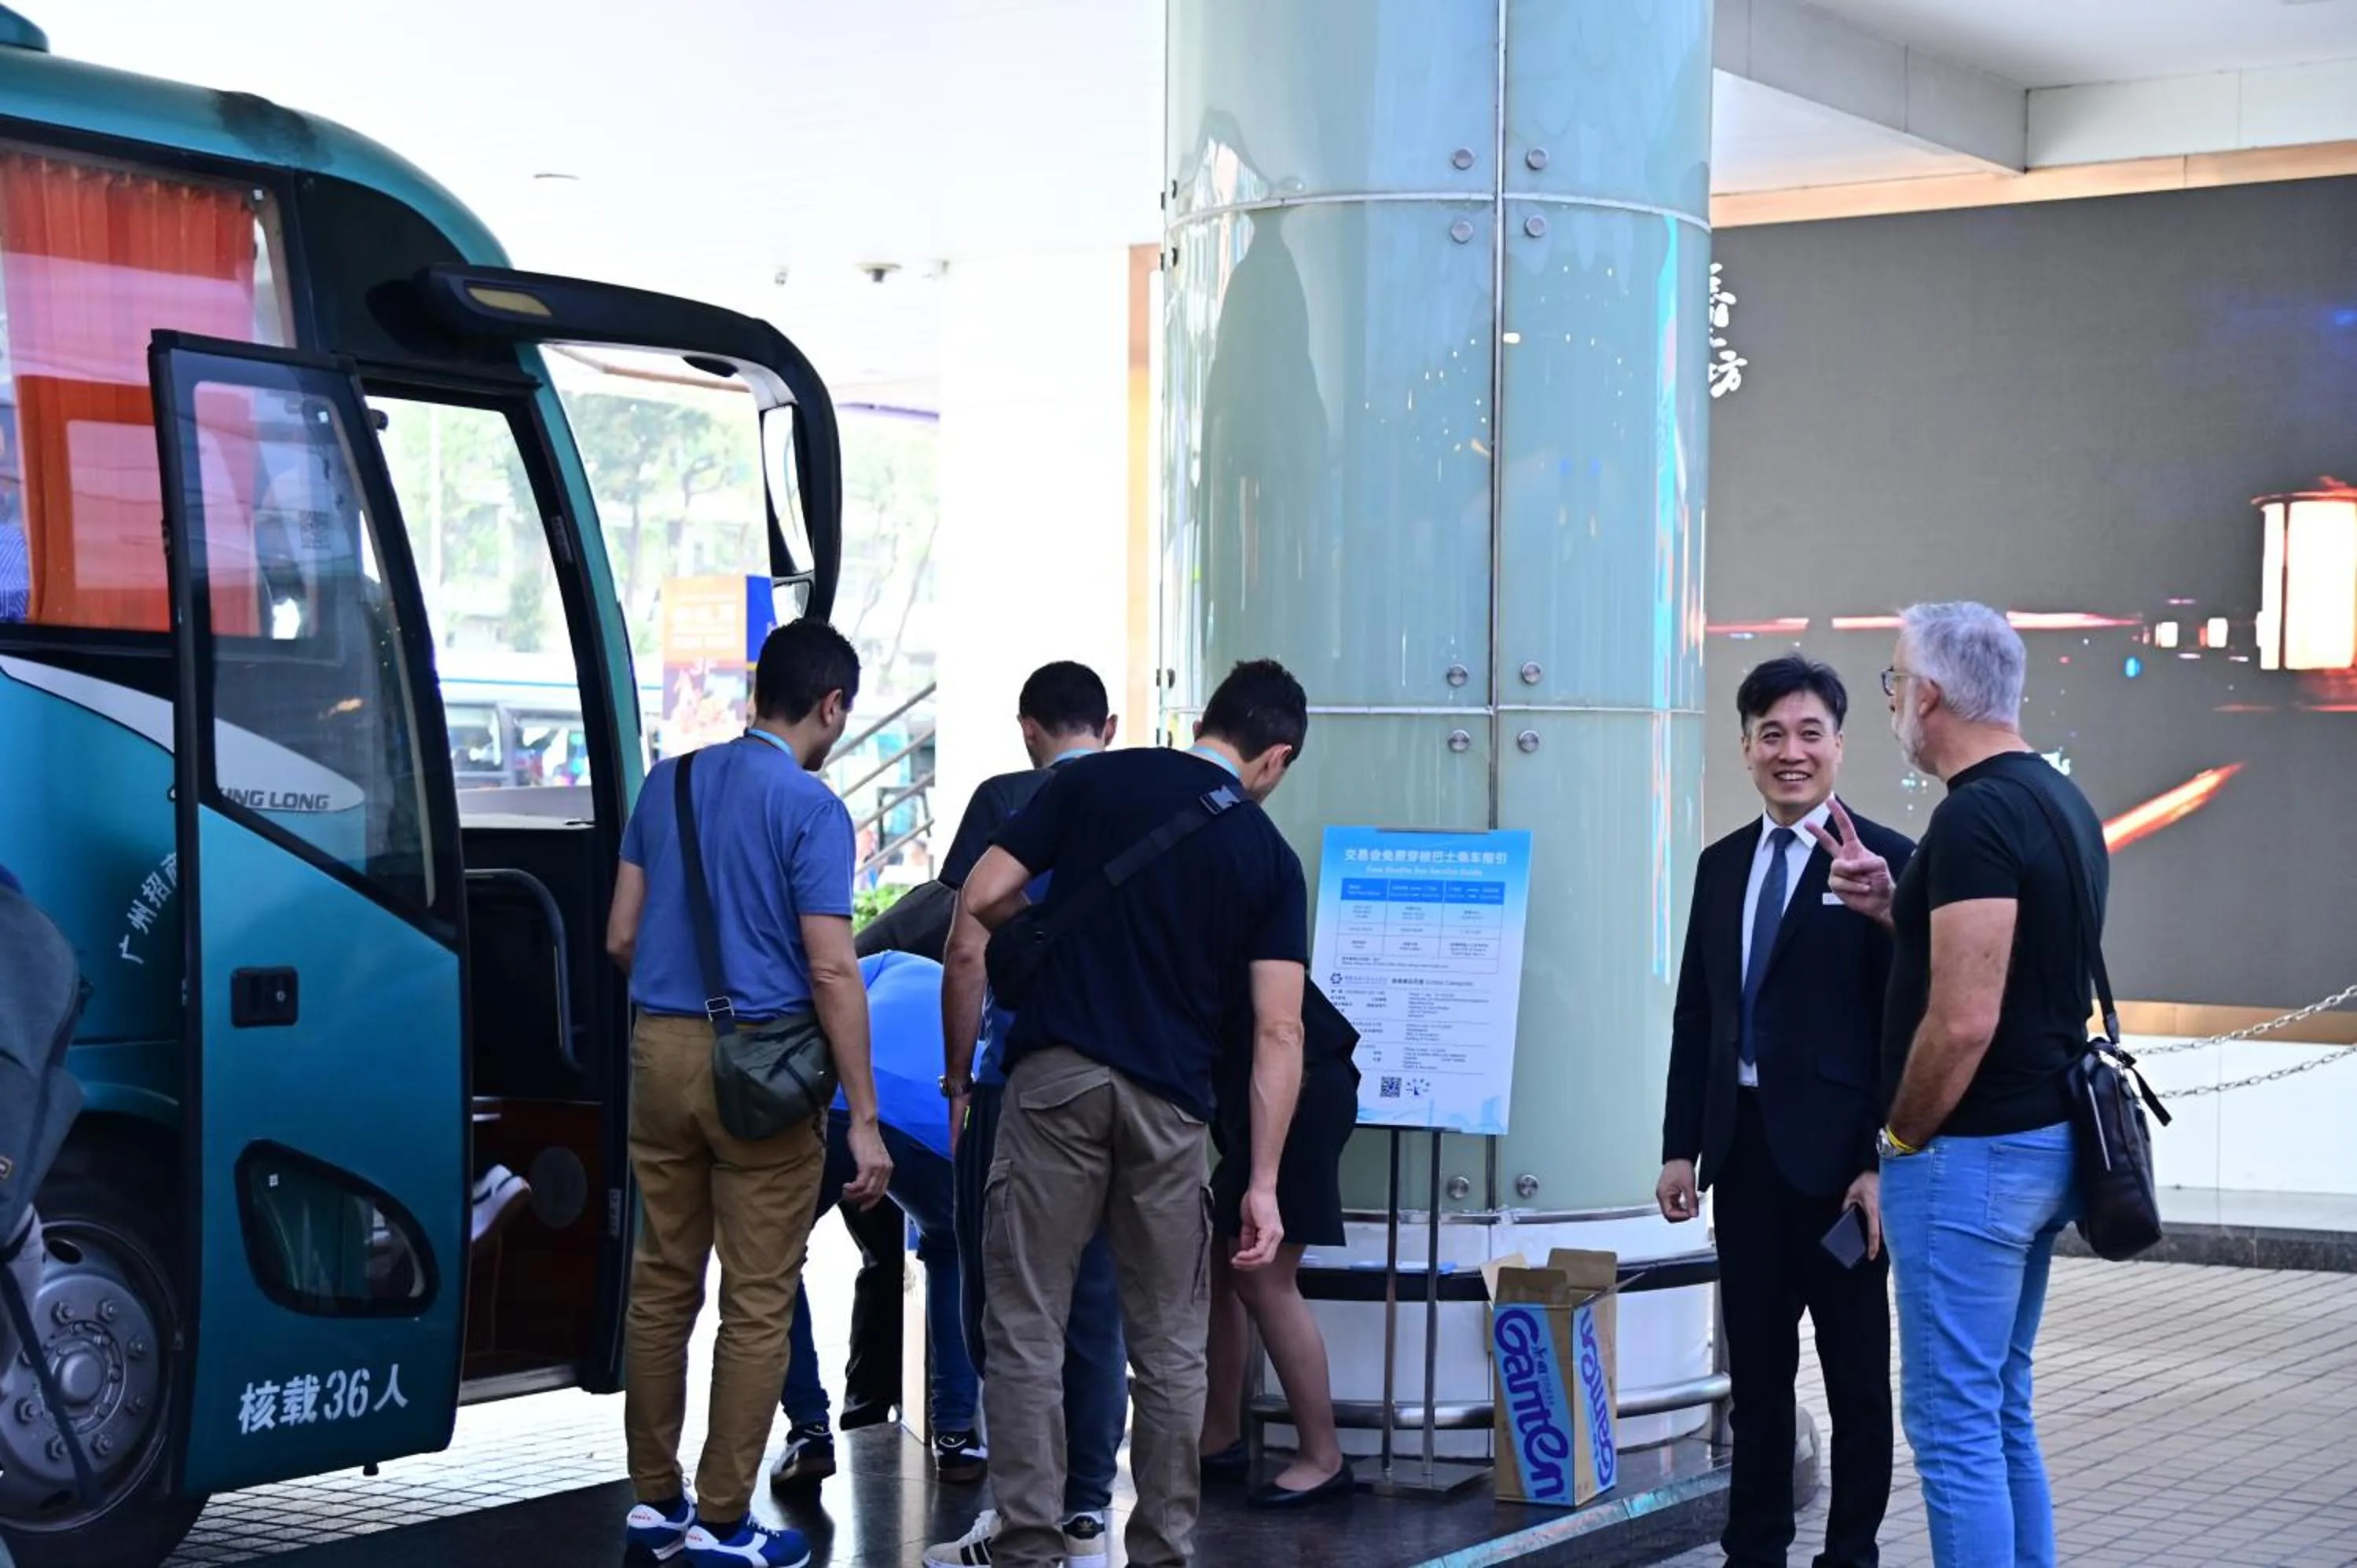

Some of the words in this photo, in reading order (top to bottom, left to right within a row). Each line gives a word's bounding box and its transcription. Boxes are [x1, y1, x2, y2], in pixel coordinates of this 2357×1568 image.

[269, 791, 330, 810] LONG
[238, 1363, 409, 1434] 核载36人
[1494, 1309, 1569, 1499] Ganten
